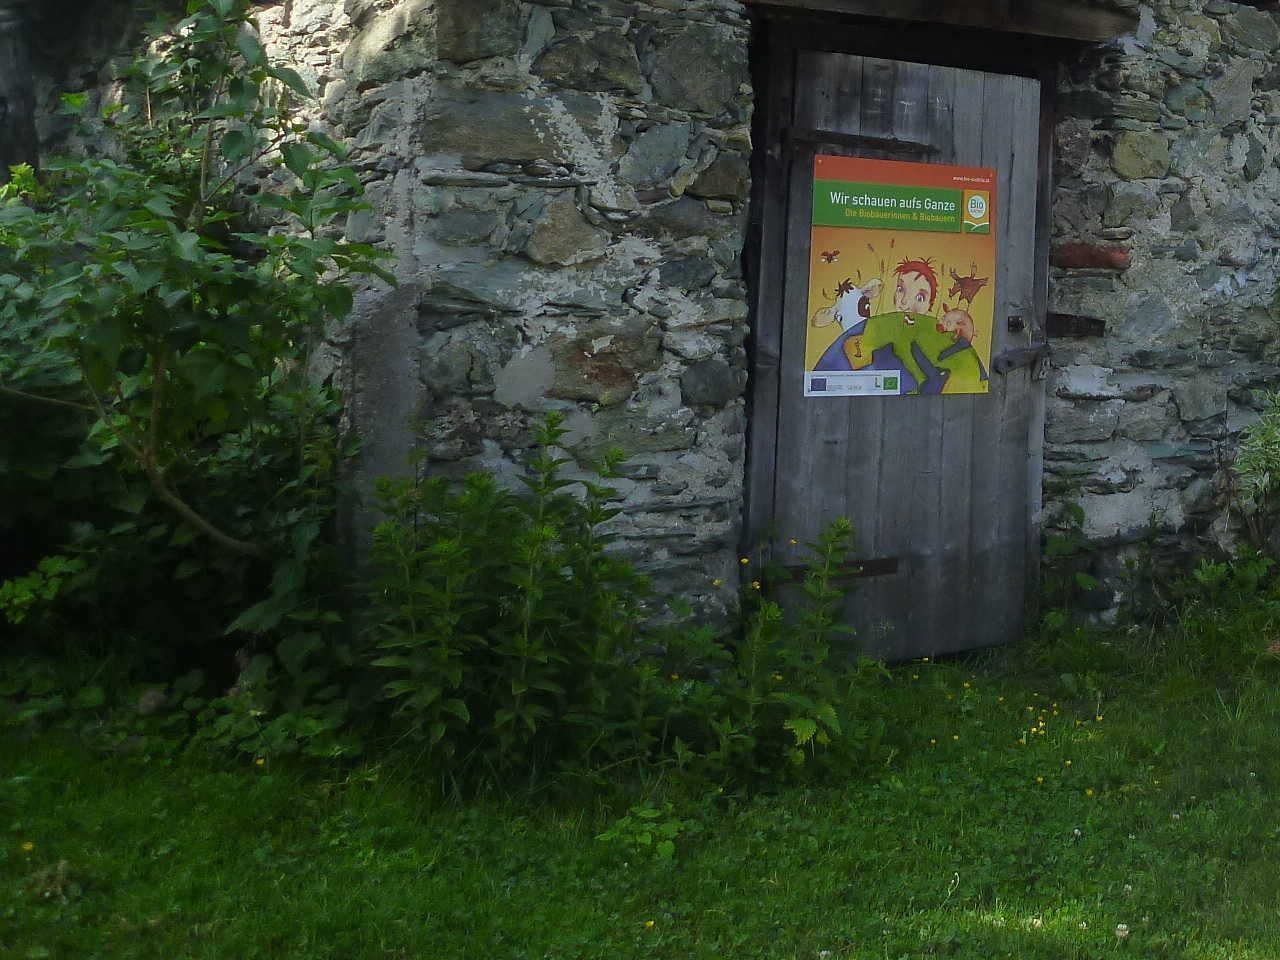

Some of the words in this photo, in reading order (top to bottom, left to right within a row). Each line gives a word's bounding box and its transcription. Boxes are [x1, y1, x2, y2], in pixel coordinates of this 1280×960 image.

[830, 191, 850, 205] Wir
[852, 194, 897, 208] schauen
[899, 197, 922, 209] aufs
[924, 198, 956, 211] Ganze
[970, 199, 984, 209] Bio
[845, 208, 858, 218] Die
